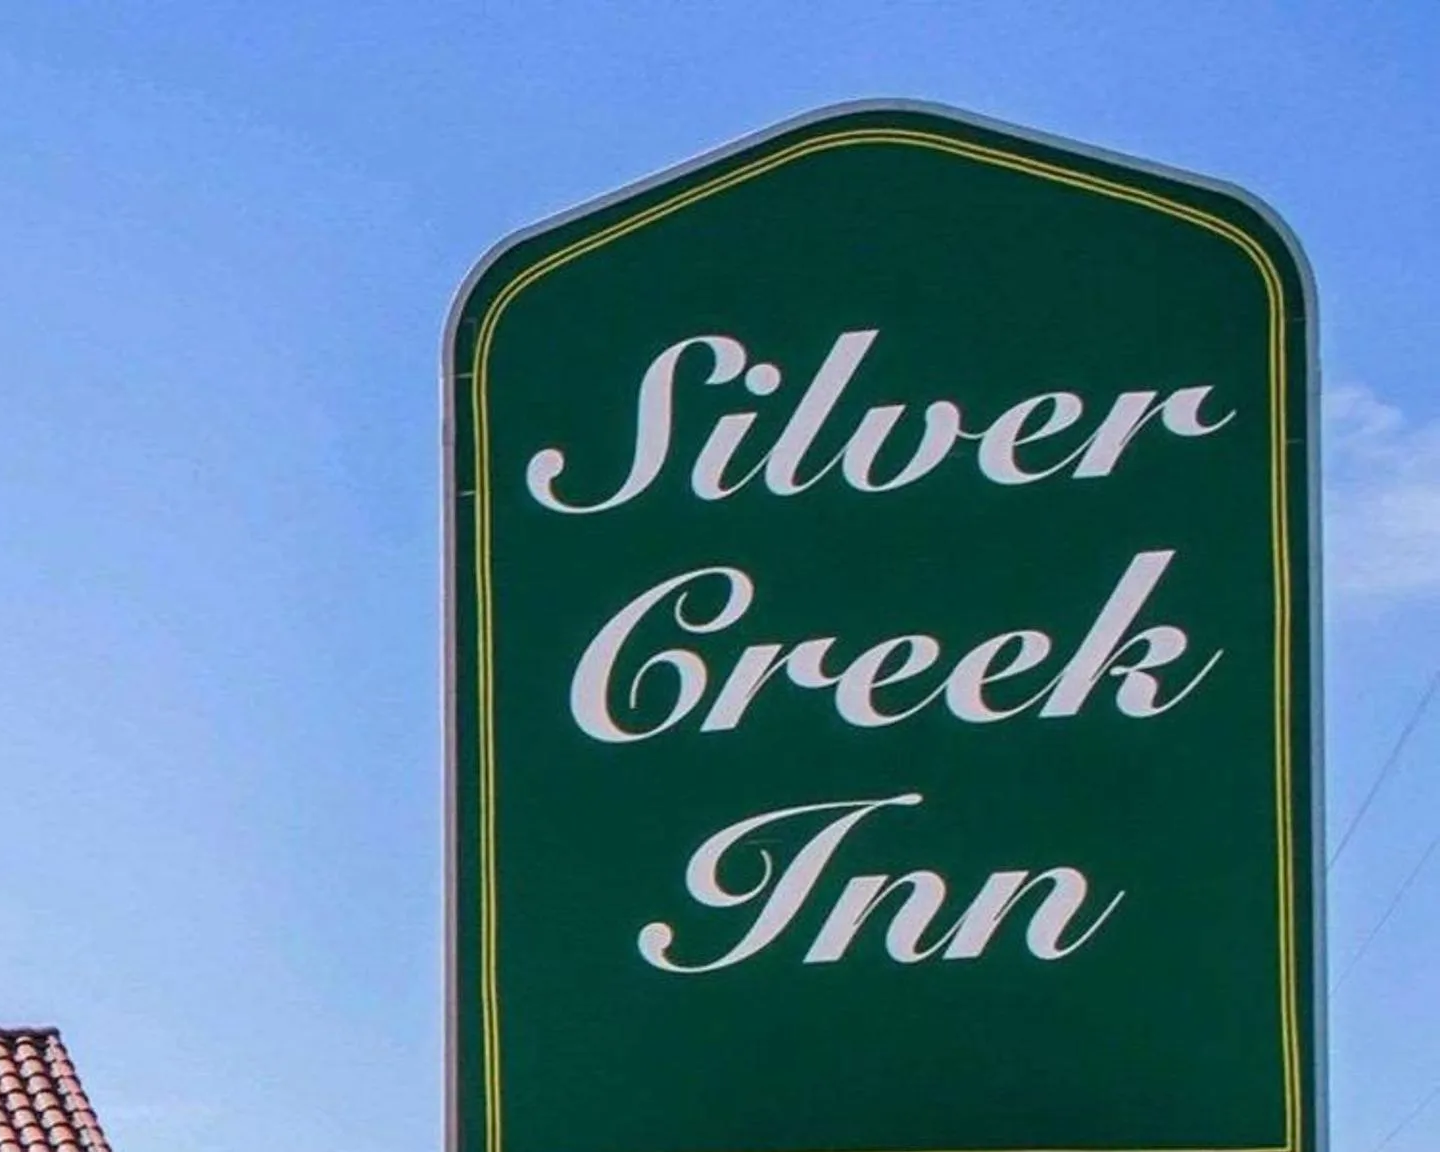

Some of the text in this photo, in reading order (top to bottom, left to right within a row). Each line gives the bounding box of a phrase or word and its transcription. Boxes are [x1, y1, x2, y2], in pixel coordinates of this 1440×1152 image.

[526, 330, 1236, 515] Silver
[570, 549, 1223, 743] Creek
[638, 792, 1124, 974] Inn
